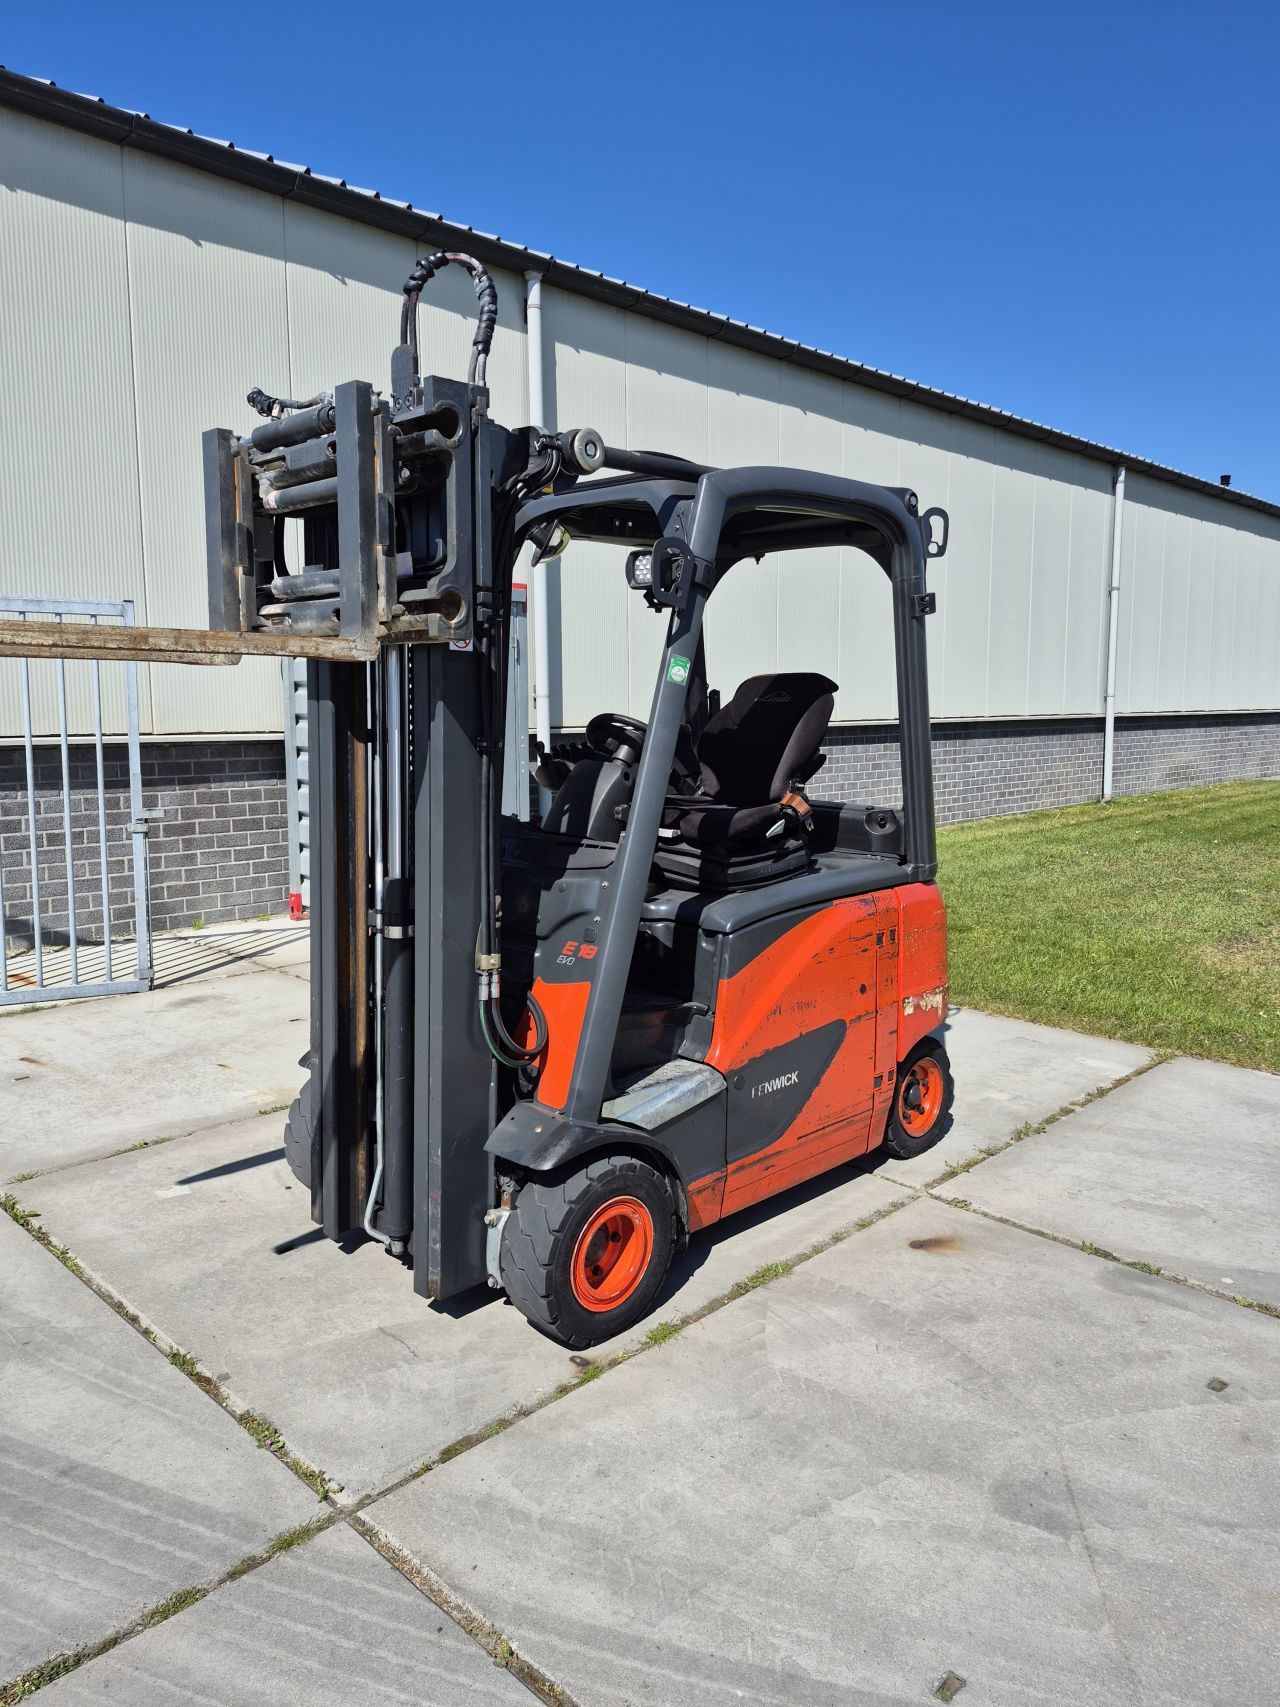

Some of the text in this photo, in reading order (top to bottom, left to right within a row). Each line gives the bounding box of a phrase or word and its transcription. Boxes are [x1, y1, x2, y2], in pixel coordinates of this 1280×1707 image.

[561, 941, 599, 960] E 18
[556, 955, 575, 966] EVO
